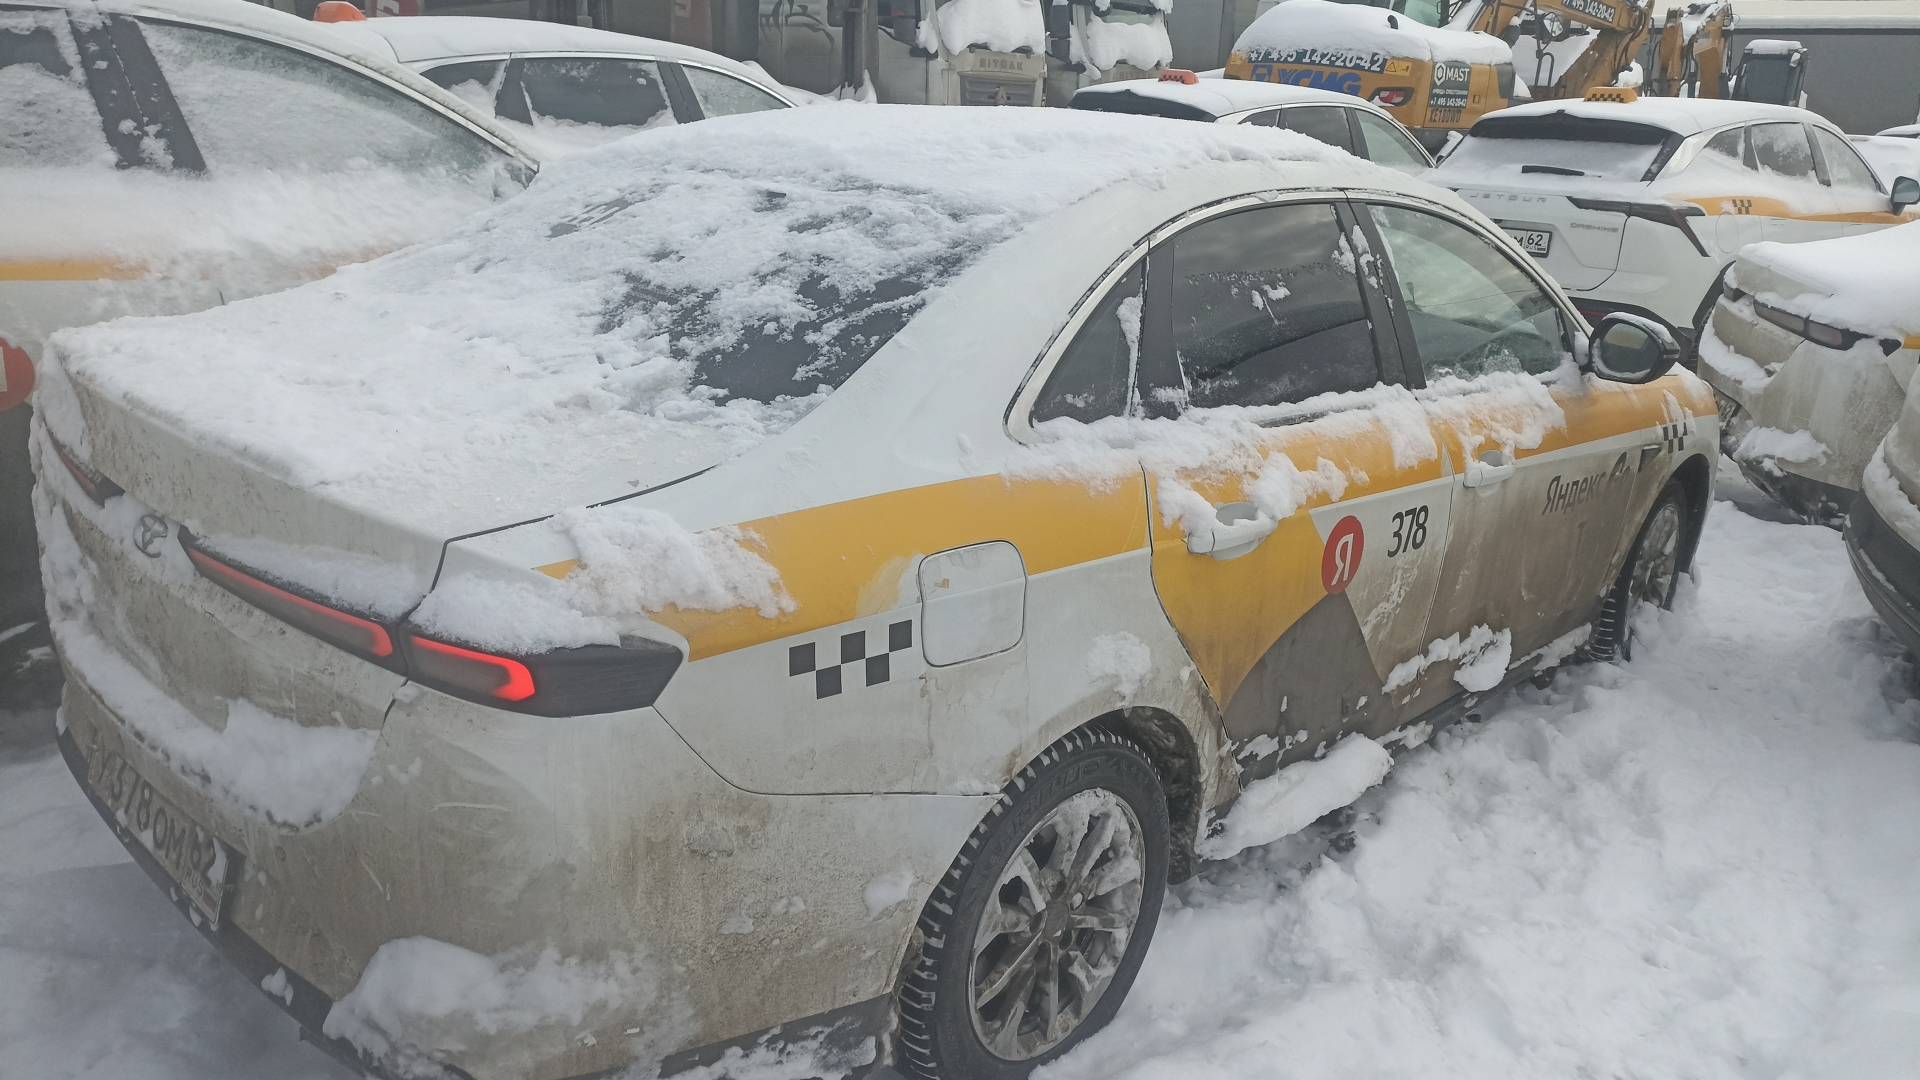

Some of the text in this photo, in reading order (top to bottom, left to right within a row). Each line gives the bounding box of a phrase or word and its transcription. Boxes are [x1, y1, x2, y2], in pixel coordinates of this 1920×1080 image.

[1302, 49, 1383, 72] 142-20-42
[1446, 67, 1469, 82] MAST
[1527, 233, 1544, 246] 62
[1387, 504, 1430, 559] 378
[1330, 533, 1355, 587] Я
